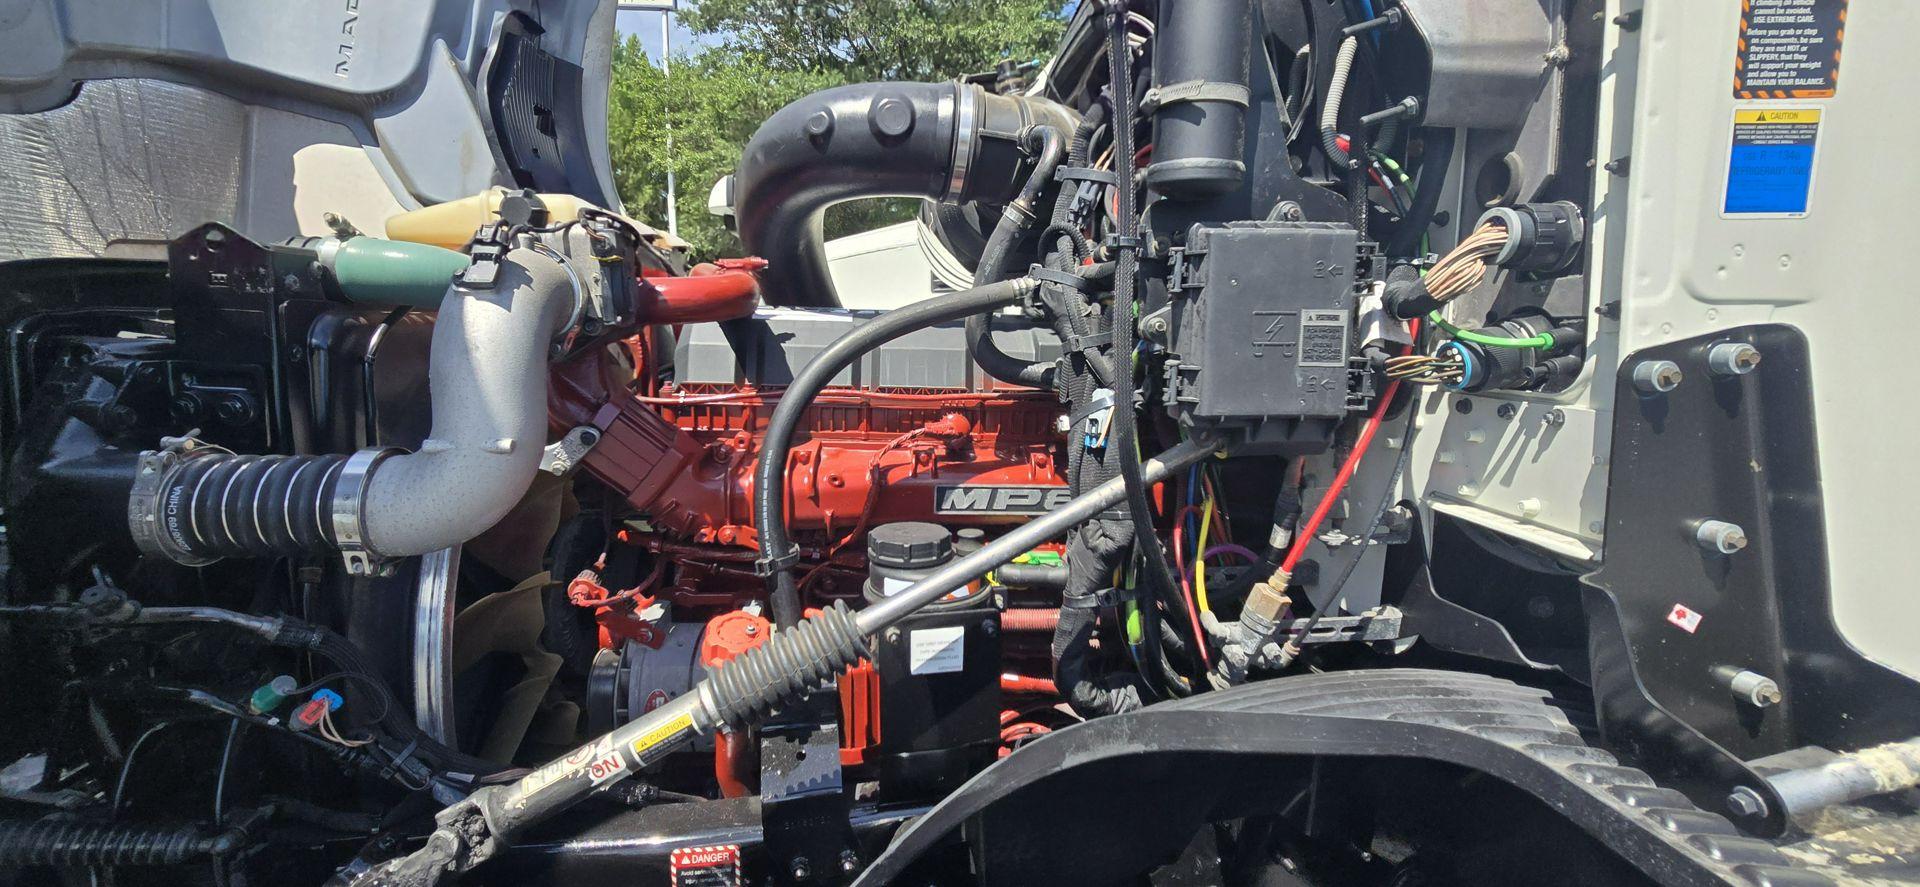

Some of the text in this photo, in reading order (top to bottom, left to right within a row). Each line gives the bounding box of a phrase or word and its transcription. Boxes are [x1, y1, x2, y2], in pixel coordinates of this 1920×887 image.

[1766, 15, 1796, 23] EXTREME
[1780, 28, 1795, 36] grab
[1803, 28, 1818, 36] step
[1793, 53, 1807, 61] they
[1760, 61, 1784, 69] support
[1777, 78, 1794, 86] YOUR
[1770, 111, 1799, 120] CAUTION
[168, 485, 184, 515] CHINA
[649, 720, 687, 743] CAUTION
[691, 852, 730, 864] DANGER
